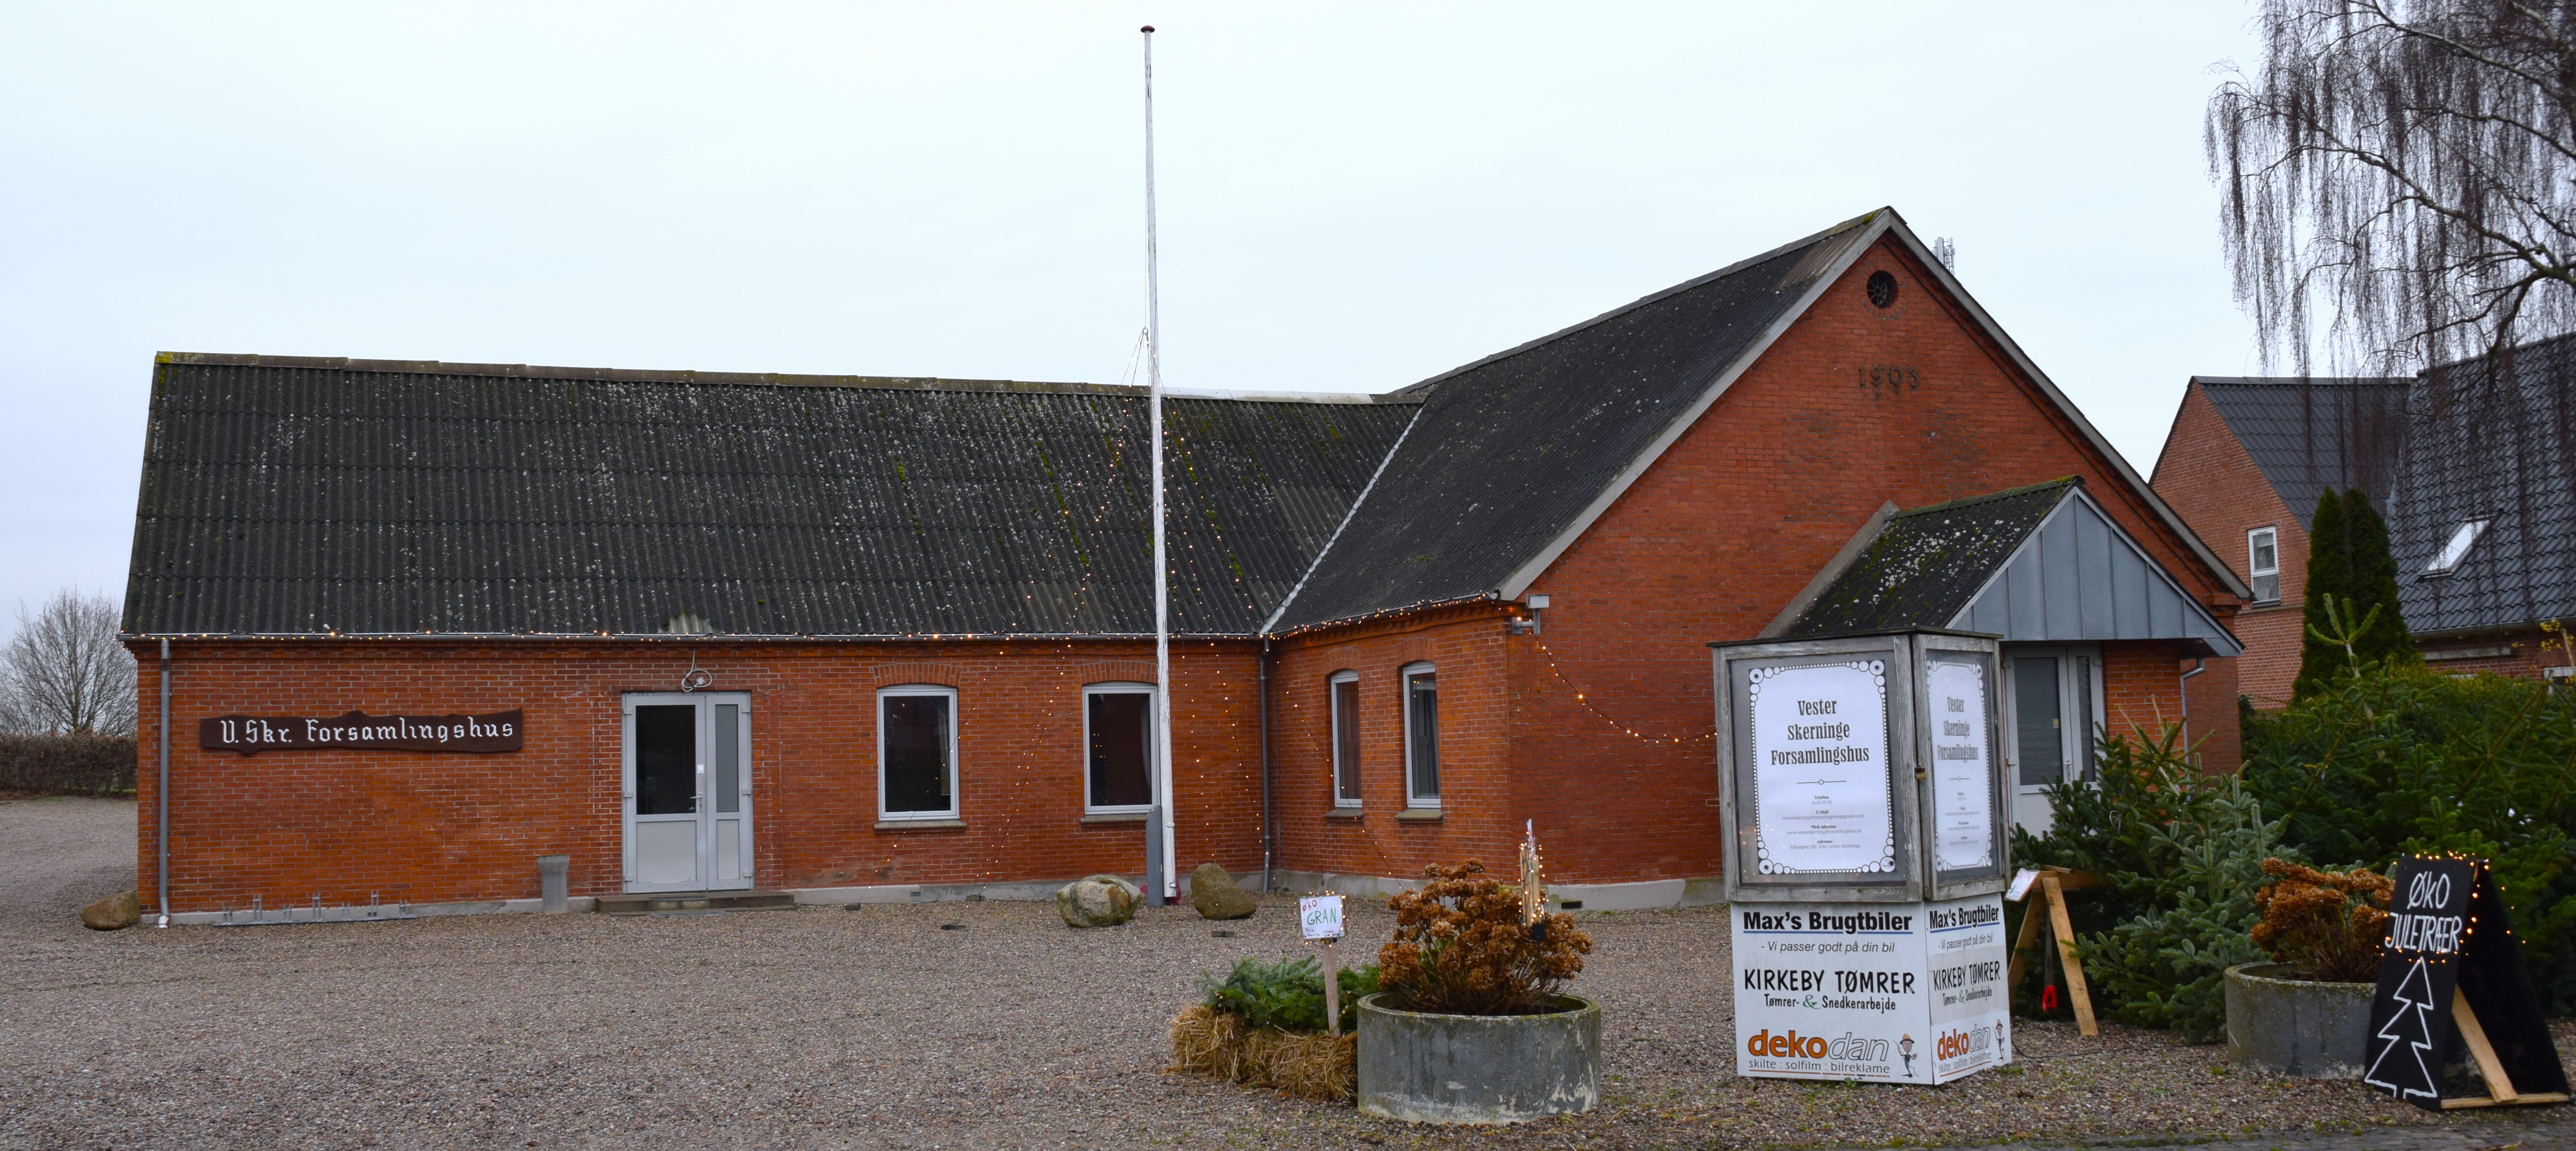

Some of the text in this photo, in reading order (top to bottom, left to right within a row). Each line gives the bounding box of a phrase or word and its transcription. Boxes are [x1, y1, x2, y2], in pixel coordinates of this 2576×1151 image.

[1798, 699, 1837, 716] Vester
[1947, 697, 1964, 712] Vester
[246, 720, 292, 743] Skr.
[306, 717, 513, 743] Forsamlingshus
[1787, 722, 1850, 741] Skerninge
[1943, 720, 1970, 739] Skerninge
[1771, 745, 1869, 765] Forsamlingshus
[1937, 744, 1979, 763] Forsamlingshus
[2407, 871, 2450, 909] ØKO
[1302, 900, 1317, 912] ØKO
[1307, 907, 1336, 925] GRAN
[1743, 911, 1913, 934] Max's Brugtbiler
[1929, 904, 1999, 929] Max's Brugtbiler
[1941, 939, 1946, 949] Vi
[1947, 939, 1962, 951] passer
[1963, 936, 1972, 949] godt
[1972, 934, 1978, 947] på
[2384, 912, 2462, 953] JULETRÆER
[1768, 941, 1777, 951] Vi
[1780, 943, 1815, 953] passer
[1818, 942, 1842, 954] godt
[1845, 941, 1859, 954] på
[1862, 942, 1879, 952] din
[1882, 942, 1895, 952] bil
[1744, 969, 1915, 994] KIRKEBY TØMRER
[1933, 961, 2000, 991] KIRKEBY TØMRER
[1764, 994, 1896, 1014] Tømrer- & Snedkerarbejde
[1958, 990, 1966, 1003] &
[1748, 1029, 1889, 1061] dekodan
[1937, 1024, 1991, 1061] dekodan
[1749, 1059, 1777, 1069] skilte
[1786, 1060, 1821, 1071] solfilm
[1831, 1062, 1890, 1073] bilreklame
[1938, 1062, 1951, 1073] skilte
[1954, 1058, 1967, 1069] solfilm
[1970, 1052, 1991, 1064] bilreklame
